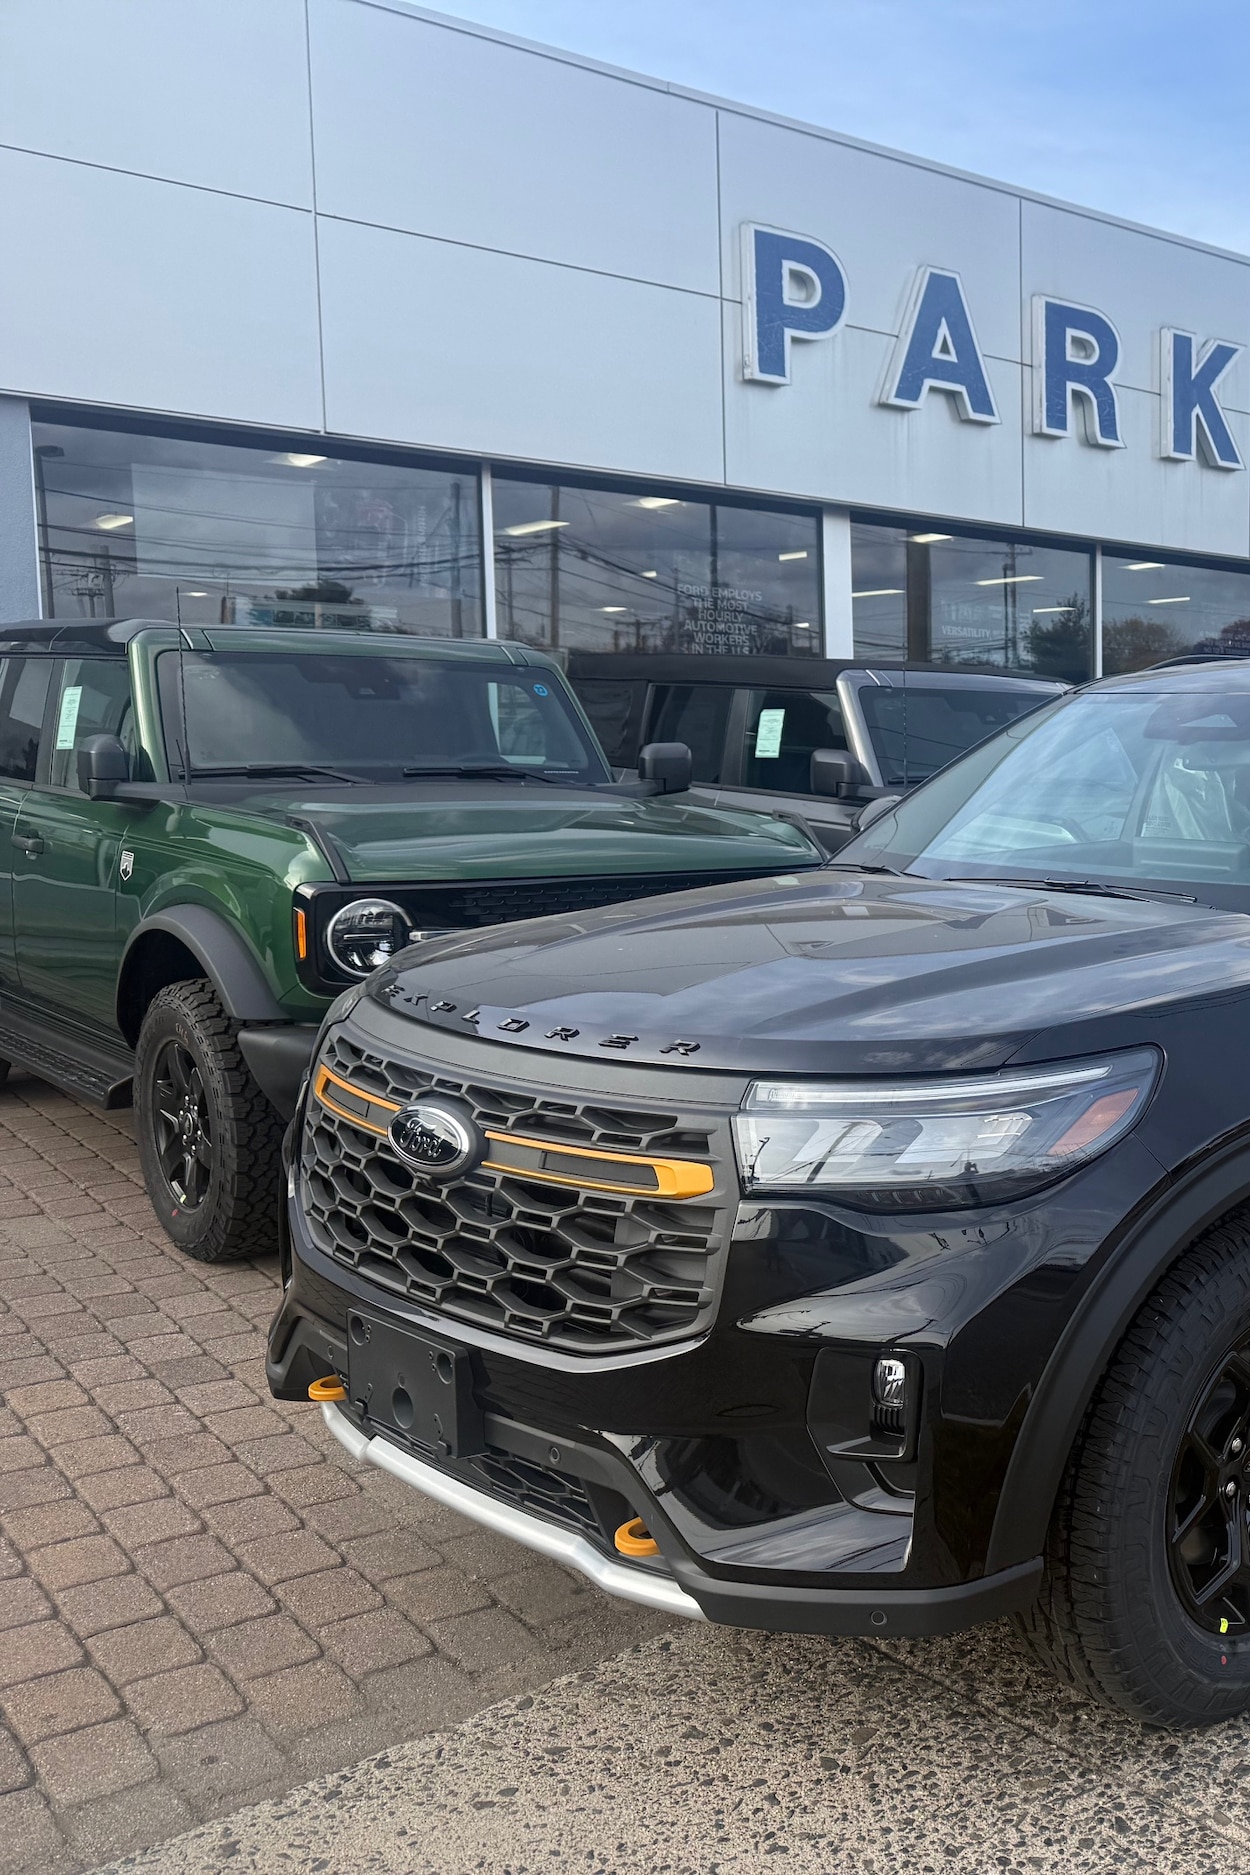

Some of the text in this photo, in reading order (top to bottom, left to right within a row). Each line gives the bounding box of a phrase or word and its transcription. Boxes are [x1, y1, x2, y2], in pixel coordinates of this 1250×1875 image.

[740, 221, 1246, 471] PARK
[677, 584, 762, 601] FORD EMPLOYS
[691, 597, 748, 611] THE MOST
[698, 610, 743, 622] HOURLY
[684, 620, 758, 635] AUTOMOTIVE
[693, 632, 750, 646] WORKERS
[382, 984, 701, 1056] EXPLORER
[400, 1117, 446, 1158] Ford
